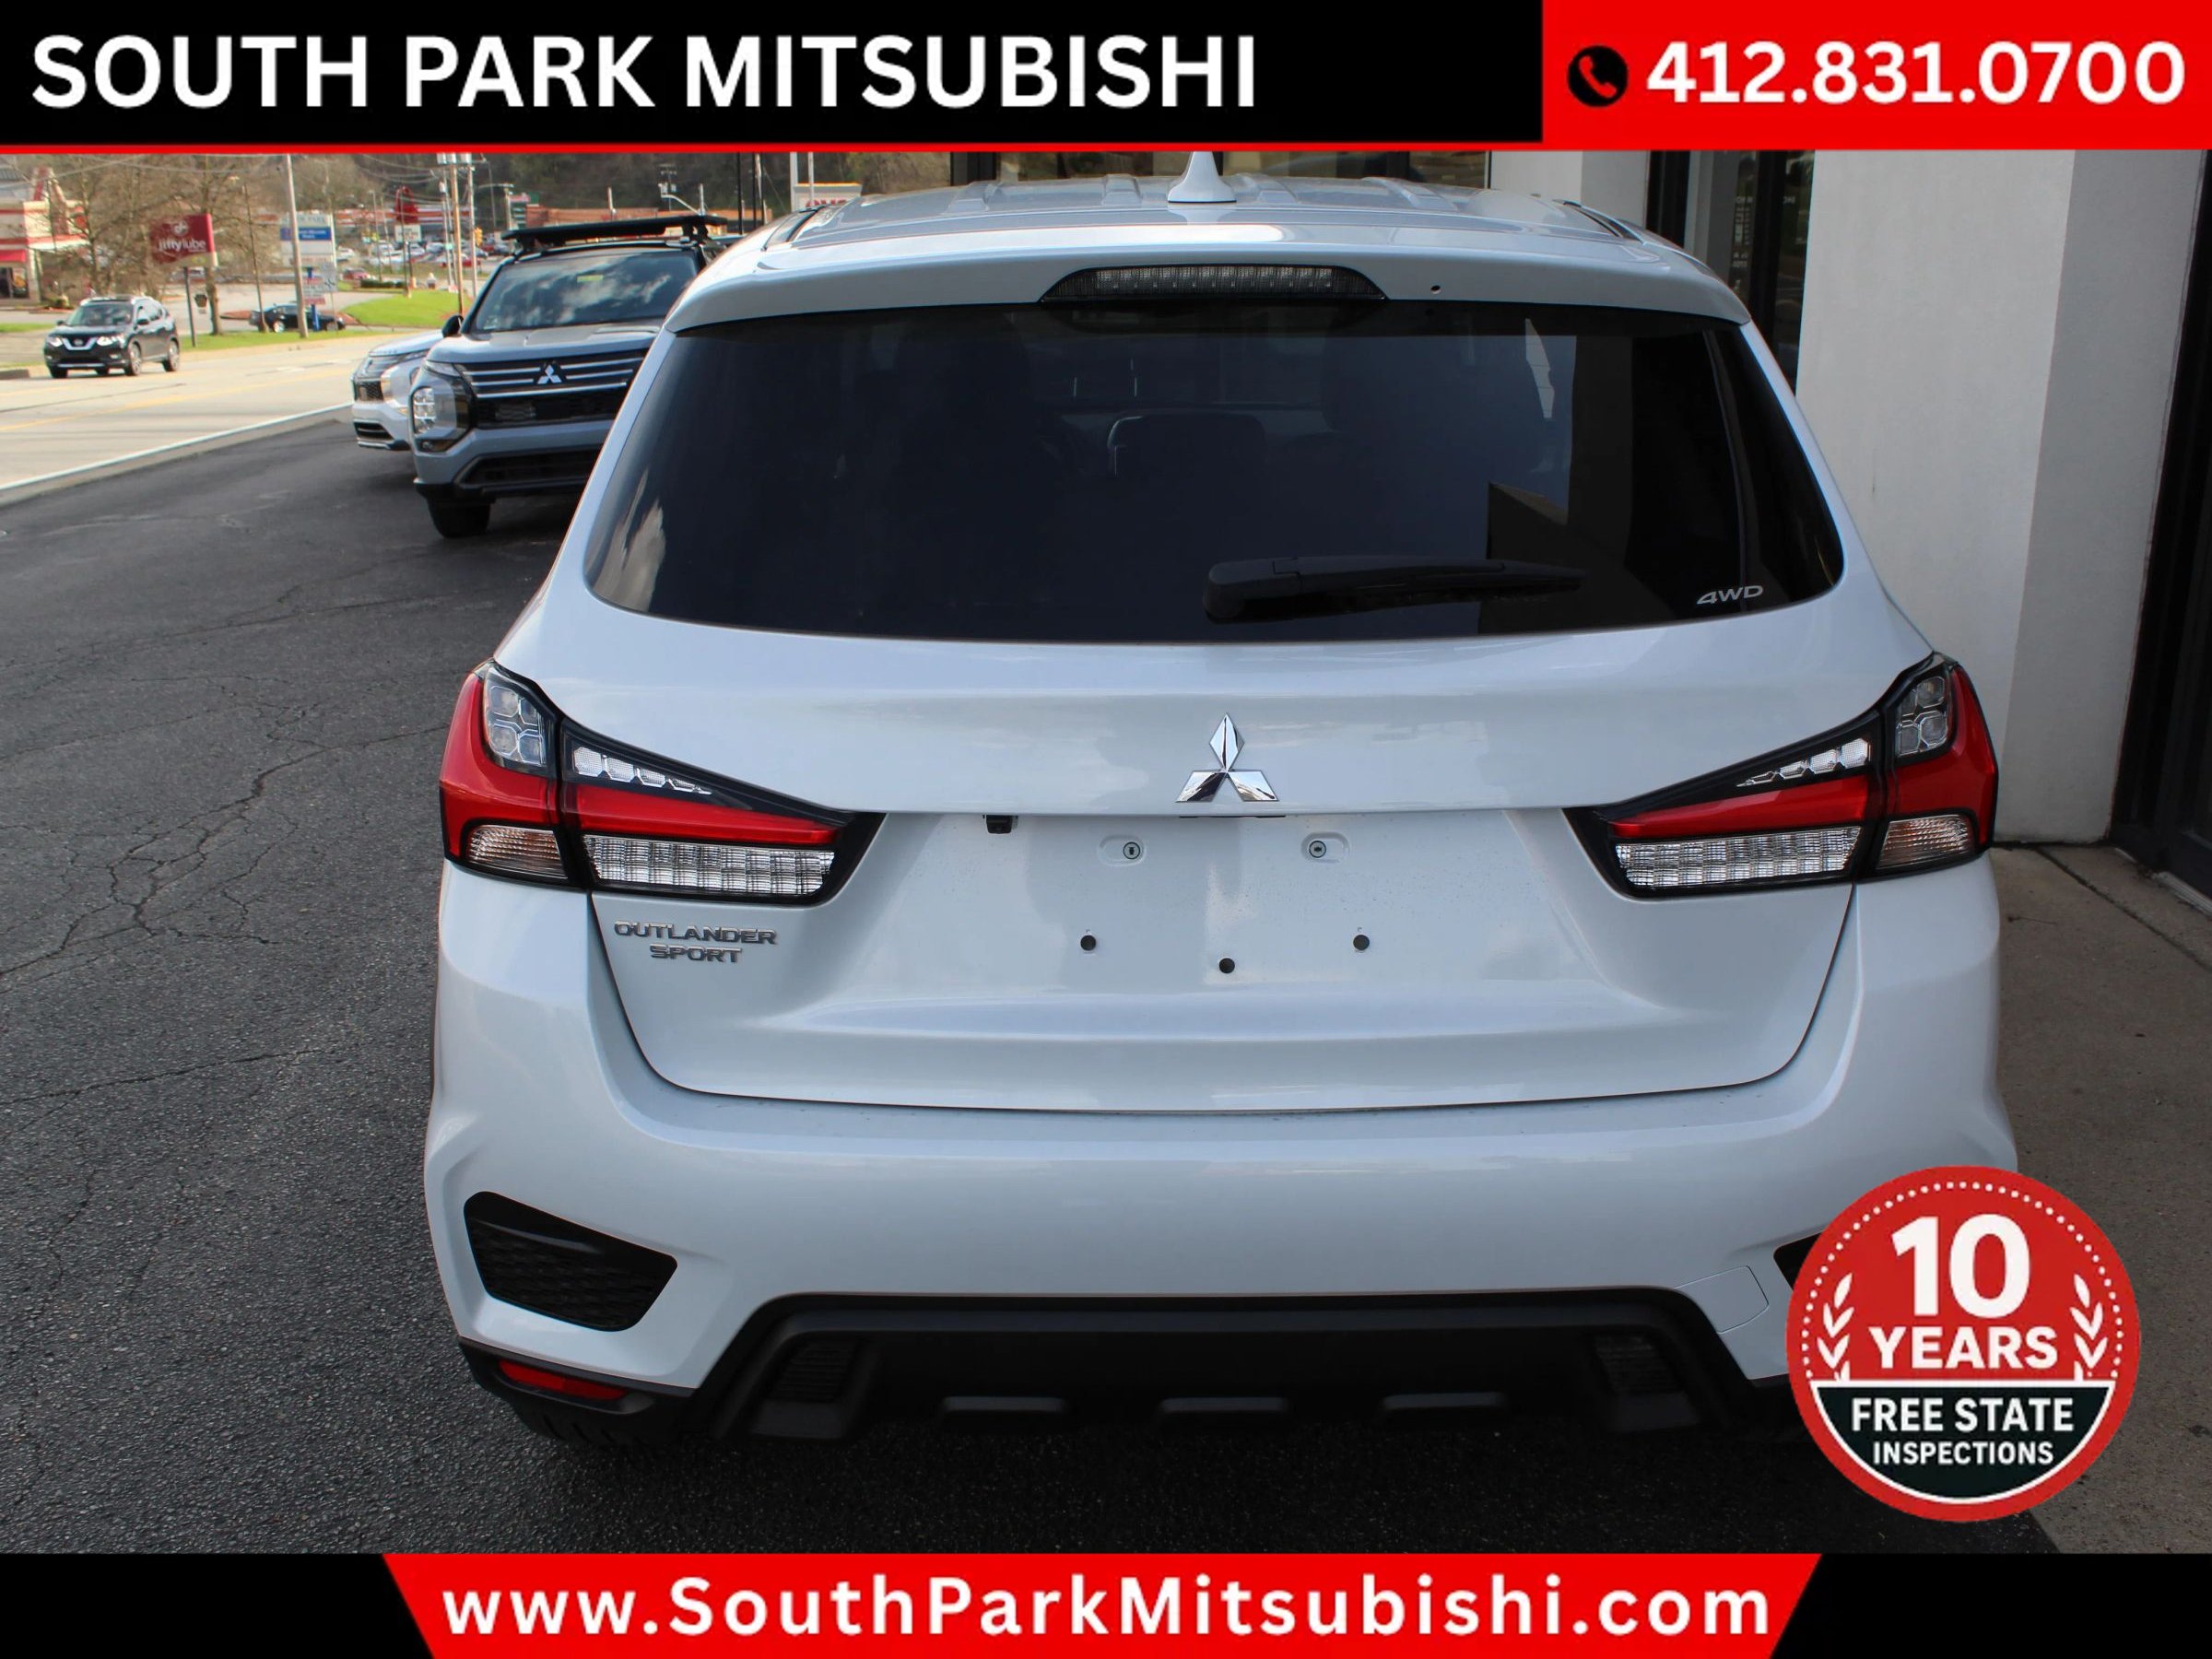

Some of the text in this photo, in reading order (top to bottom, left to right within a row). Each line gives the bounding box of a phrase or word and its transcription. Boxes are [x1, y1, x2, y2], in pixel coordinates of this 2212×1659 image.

[1696, 585, 1764, 605] 4WD
[614, 921, 778, 945] OUTLANDER
[649, 943, 744, 963] SPORT
